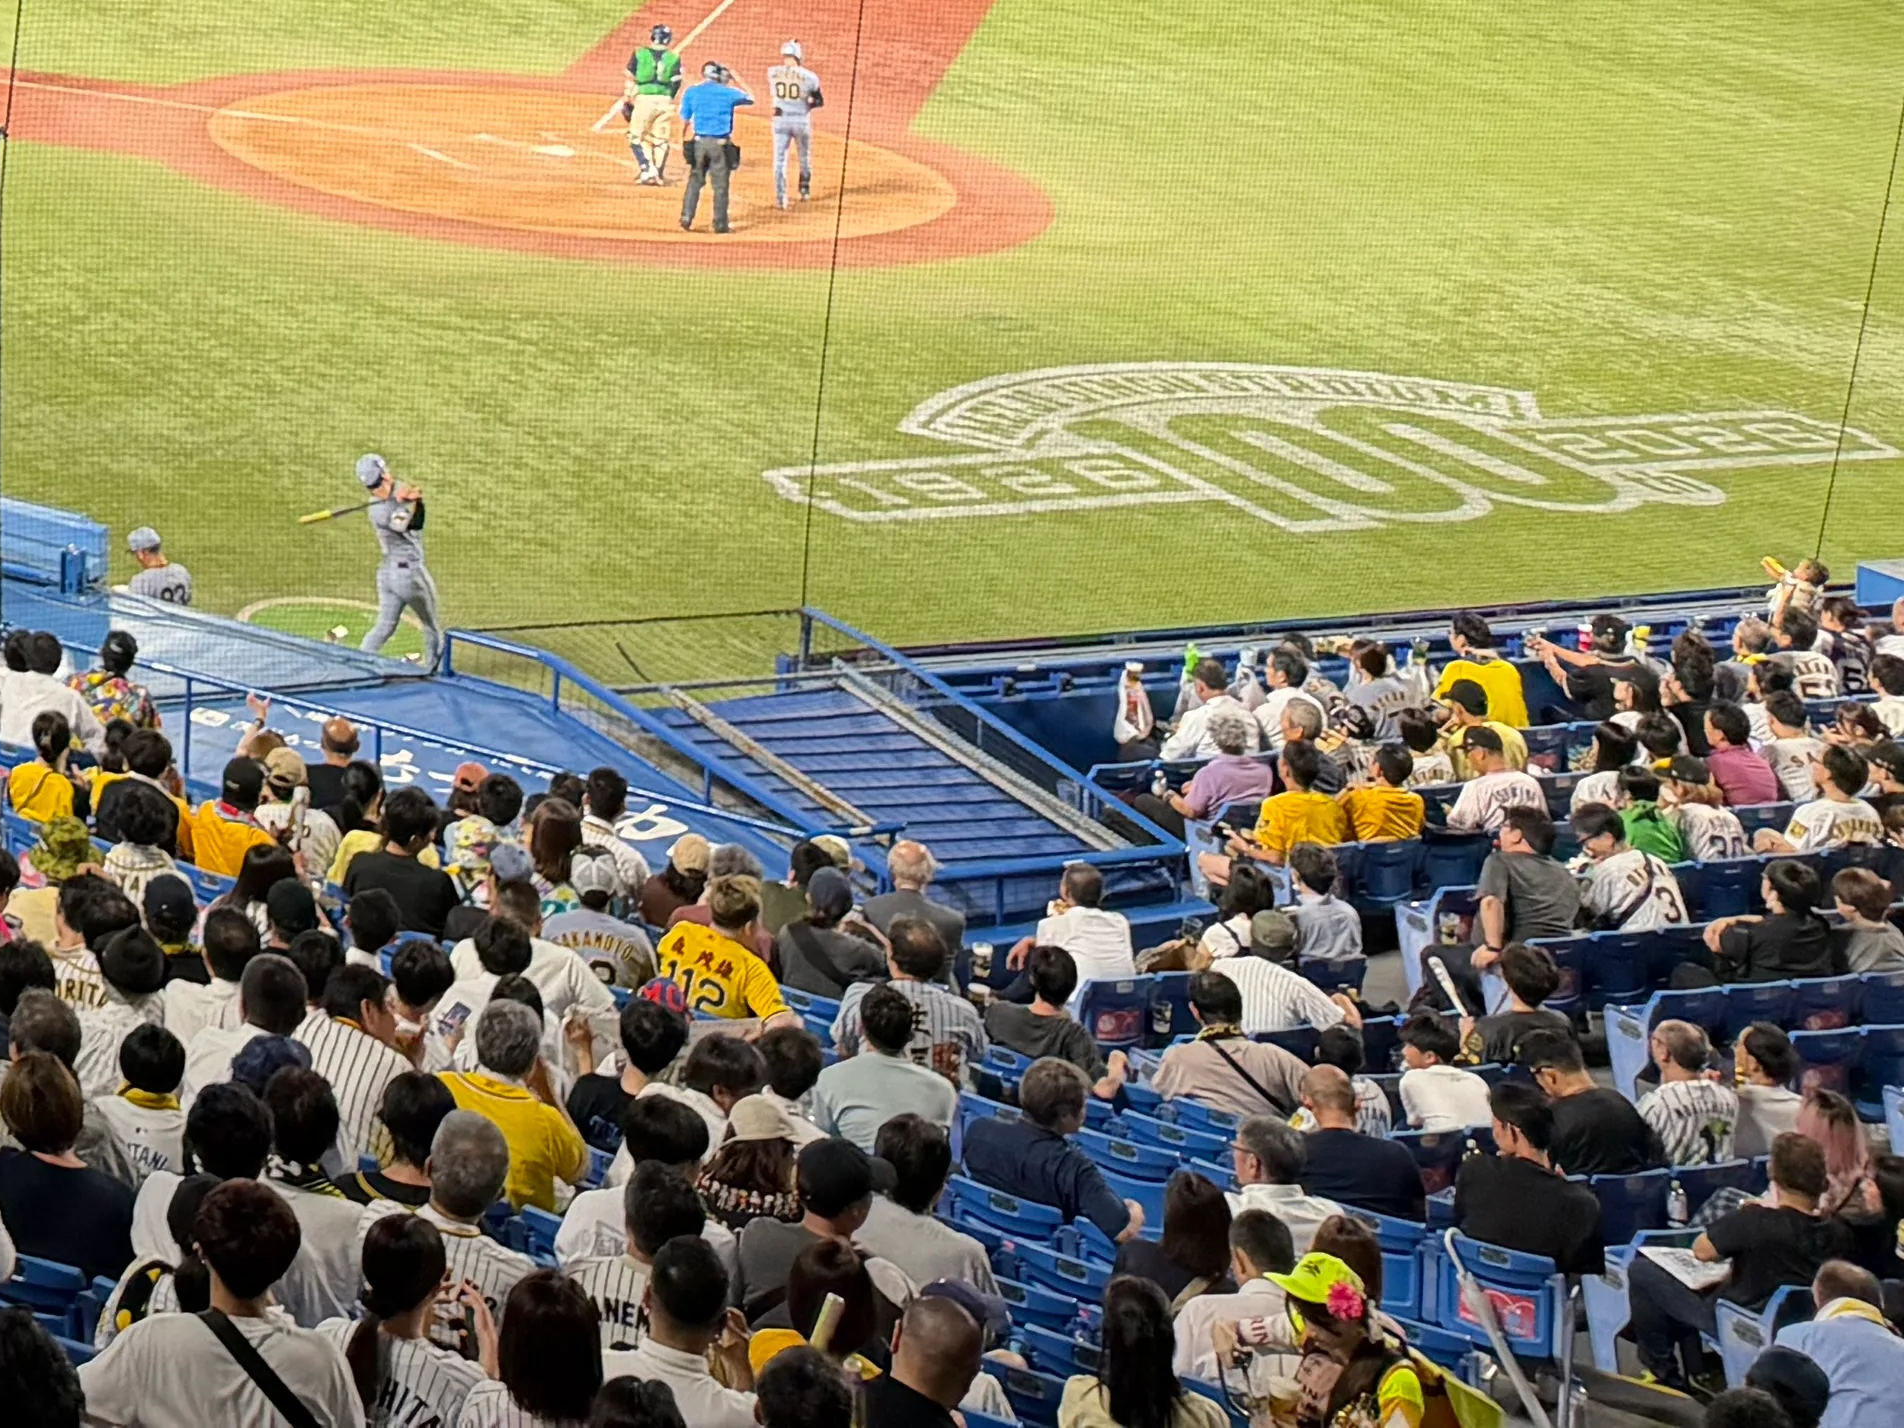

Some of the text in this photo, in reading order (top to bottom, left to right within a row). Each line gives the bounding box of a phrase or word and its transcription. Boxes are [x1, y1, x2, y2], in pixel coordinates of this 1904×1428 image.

[1054, 374, 1206, 402] JINGU
[1207, 373, 1494, 409] STADIUM
[847, 456, 1149, 508] 1926
[1656, 885, 1681, 923] 3
[666, 958, 726, 1010] 112
